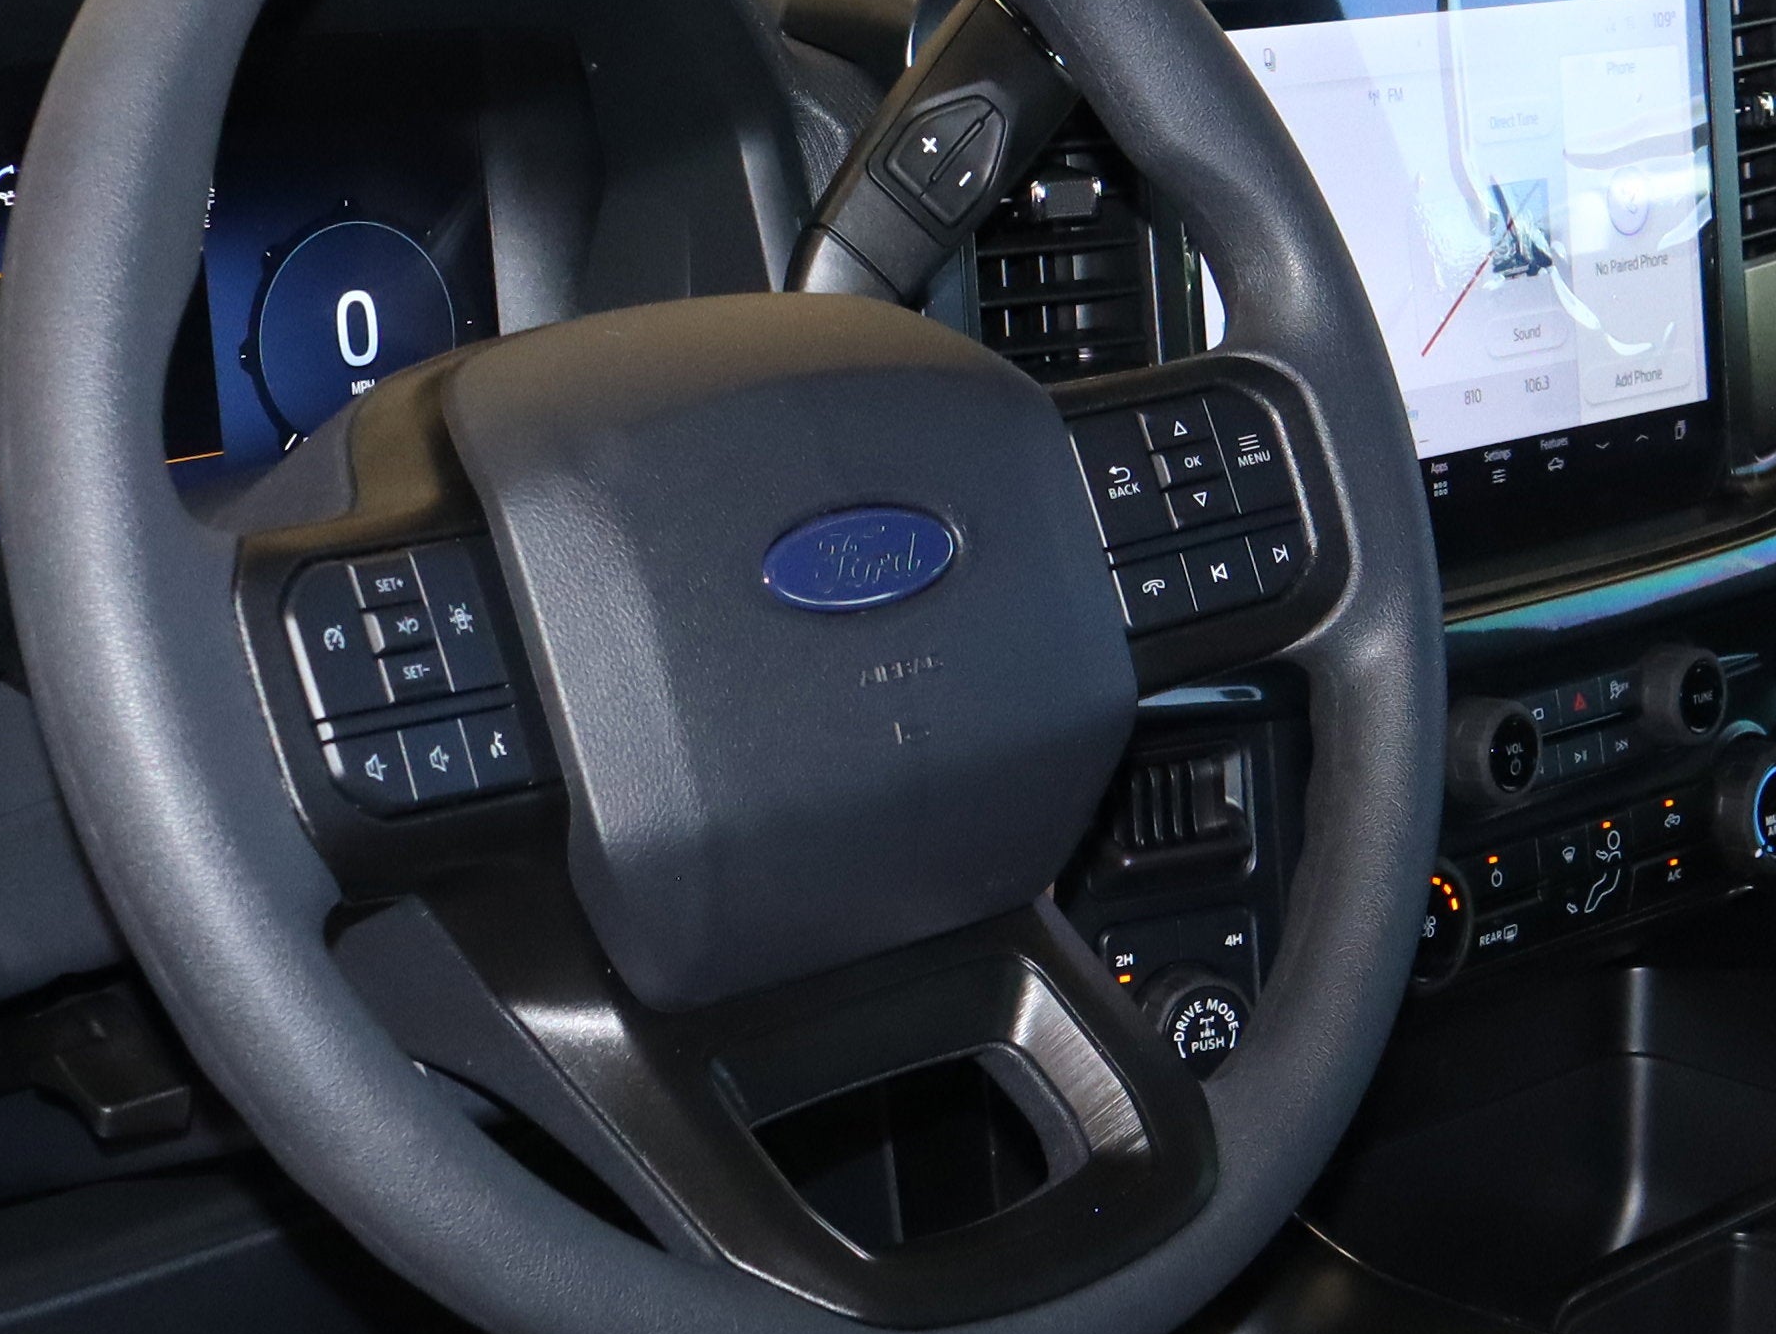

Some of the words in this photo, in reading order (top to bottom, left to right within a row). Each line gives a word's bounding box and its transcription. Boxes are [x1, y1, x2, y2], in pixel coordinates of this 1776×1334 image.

[1387, 87, 1404, 103] FM
[1640, 254, 1669, 269] Phone
[336, 289, 378, 367] 0
[1513, 326, 1541, 342] Sound
[1615, 373, 1632, 388] Add
[1633, 368, 1663, 384] Phone
[1464, 389, 1482, 405] 810
[1184, 455, 1202, 469] OK
[1237, 450, 1271, 468] MENU
[1107, 482, 1141, 500] BACK
[1693, 689, 1714, 705] TUNE
[1505, 742, 1524, 757] VOL
[1224, 932, 1242, 947] 4H
[1479, 930, 1503, 947] REAR
[1115, 953, 1133, 967] 2H
[1173, 1000, 1204, 1042] DRIVE
[1206, 997, 1239, 1032] MODE
[1191, 1036, 1225, 1054] PUSH
